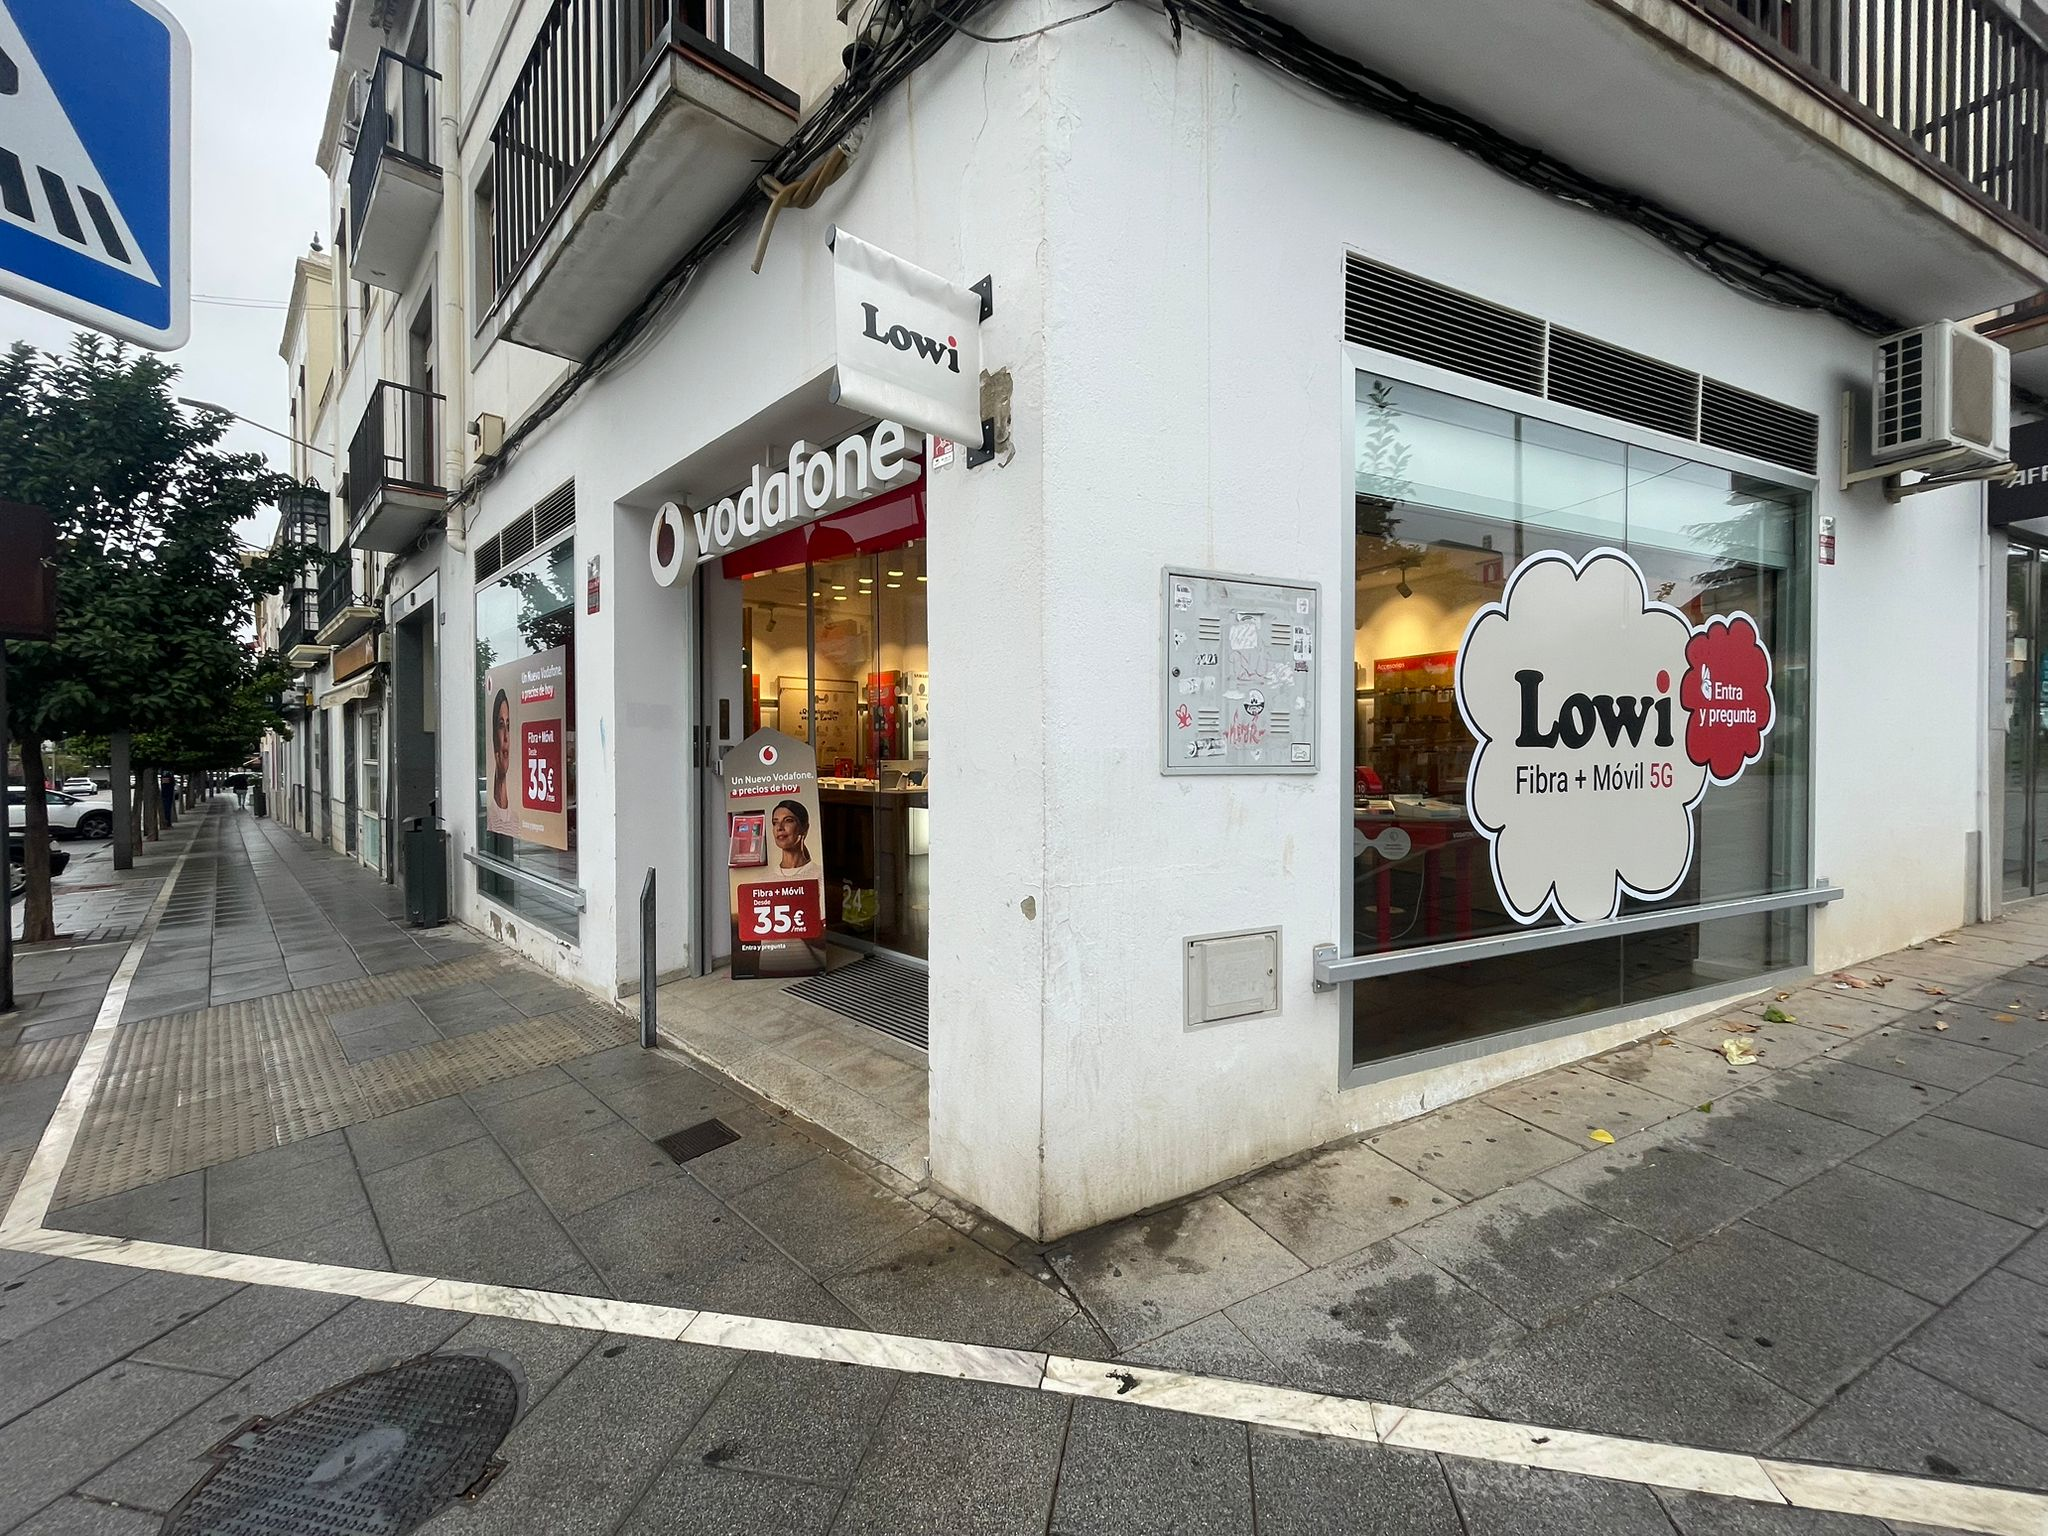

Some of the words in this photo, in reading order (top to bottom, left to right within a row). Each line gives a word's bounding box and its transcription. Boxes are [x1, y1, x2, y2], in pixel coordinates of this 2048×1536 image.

[860, 302, 961, 373] Lowi
[693, 419, 906, 556] vodafone
[1715, 682, 1743, 701] Entra
[1514, 669, 1675, 750] Lowi
[1699, 708, 1706, 727] y
[1709, 707, 1757, 727] pregunta
[731, 776, 744, 785] Un
[745, 775, 772, 785] Nuevo
[1516, 764, 1569, 795] Fibra
[1575, 769, 1587, 789] +
[1593, 762, 1644, 791] Móvil
[1650, 762, 1674, 789] 5G
[738, 785, 769, 797] precios
[770, 783, 781, 793] de
[782, 782, 798, 793] hoy
[752, 889, 774, 898] Fibra
[781, 886, 804, 896] Móvil
[753, 905, 805, 935] 35€
[761, 943, 786, 951] pregunta
